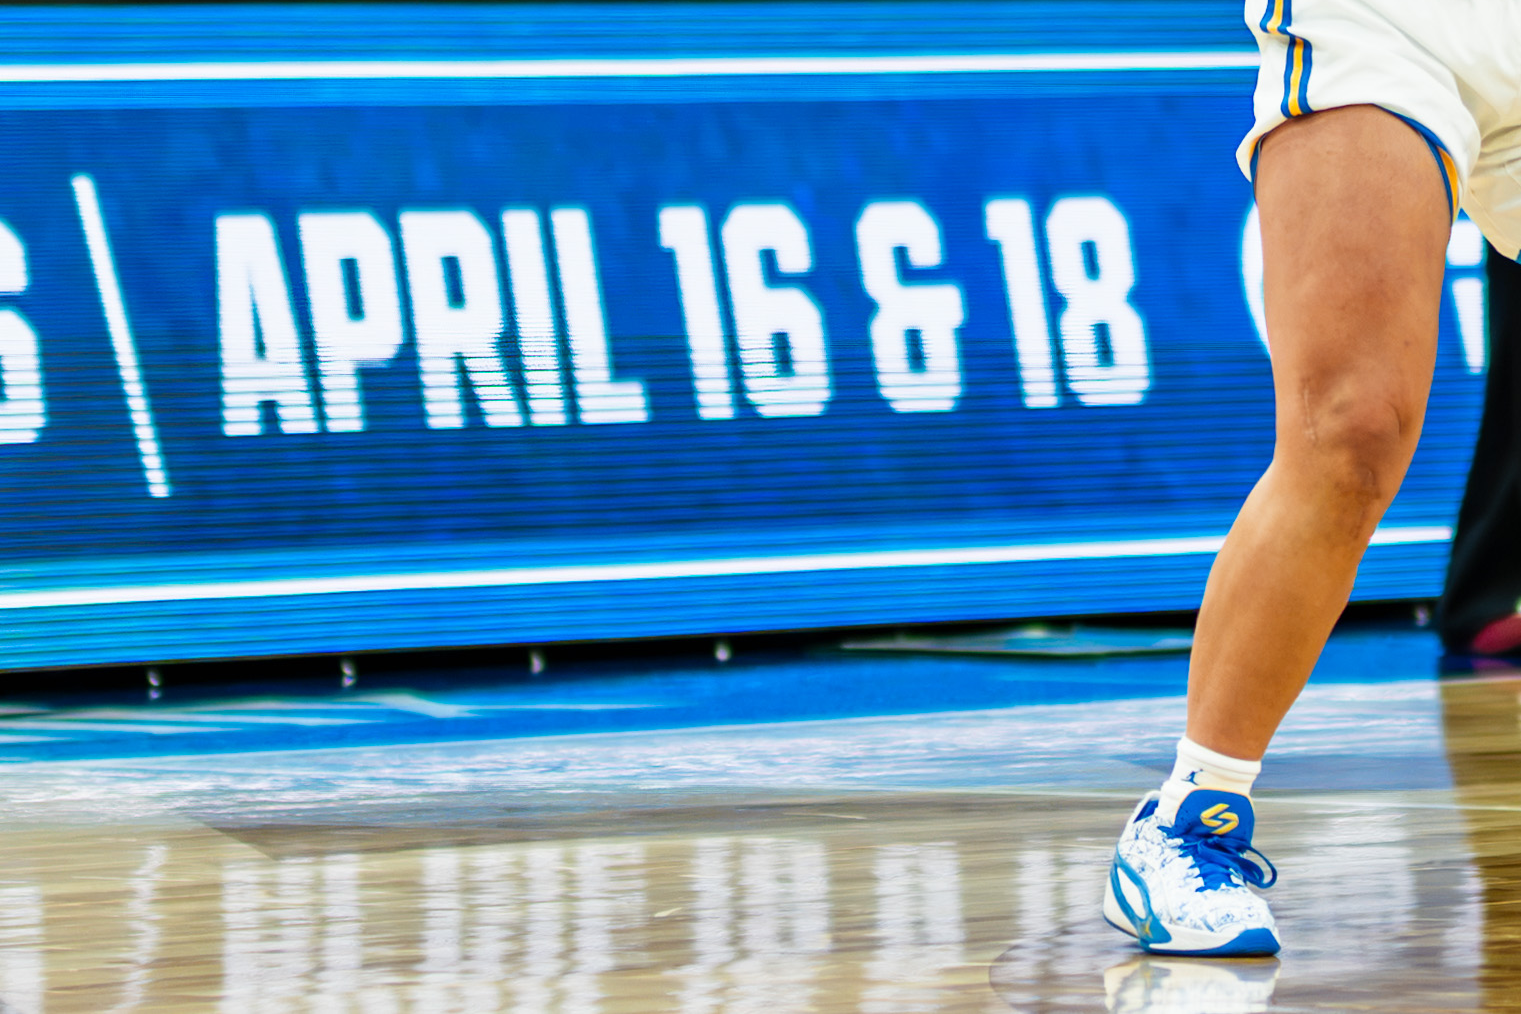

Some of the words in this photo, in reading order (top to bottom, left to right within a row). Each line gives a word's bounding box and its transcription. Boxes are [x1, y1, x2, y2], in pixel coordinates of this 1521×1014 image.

[215, 209, 650, 437] APRIL
[658, 204, 832, 420] 16
[855, 200, 966, 413] &
[985, 196, 1151, 409] 18
